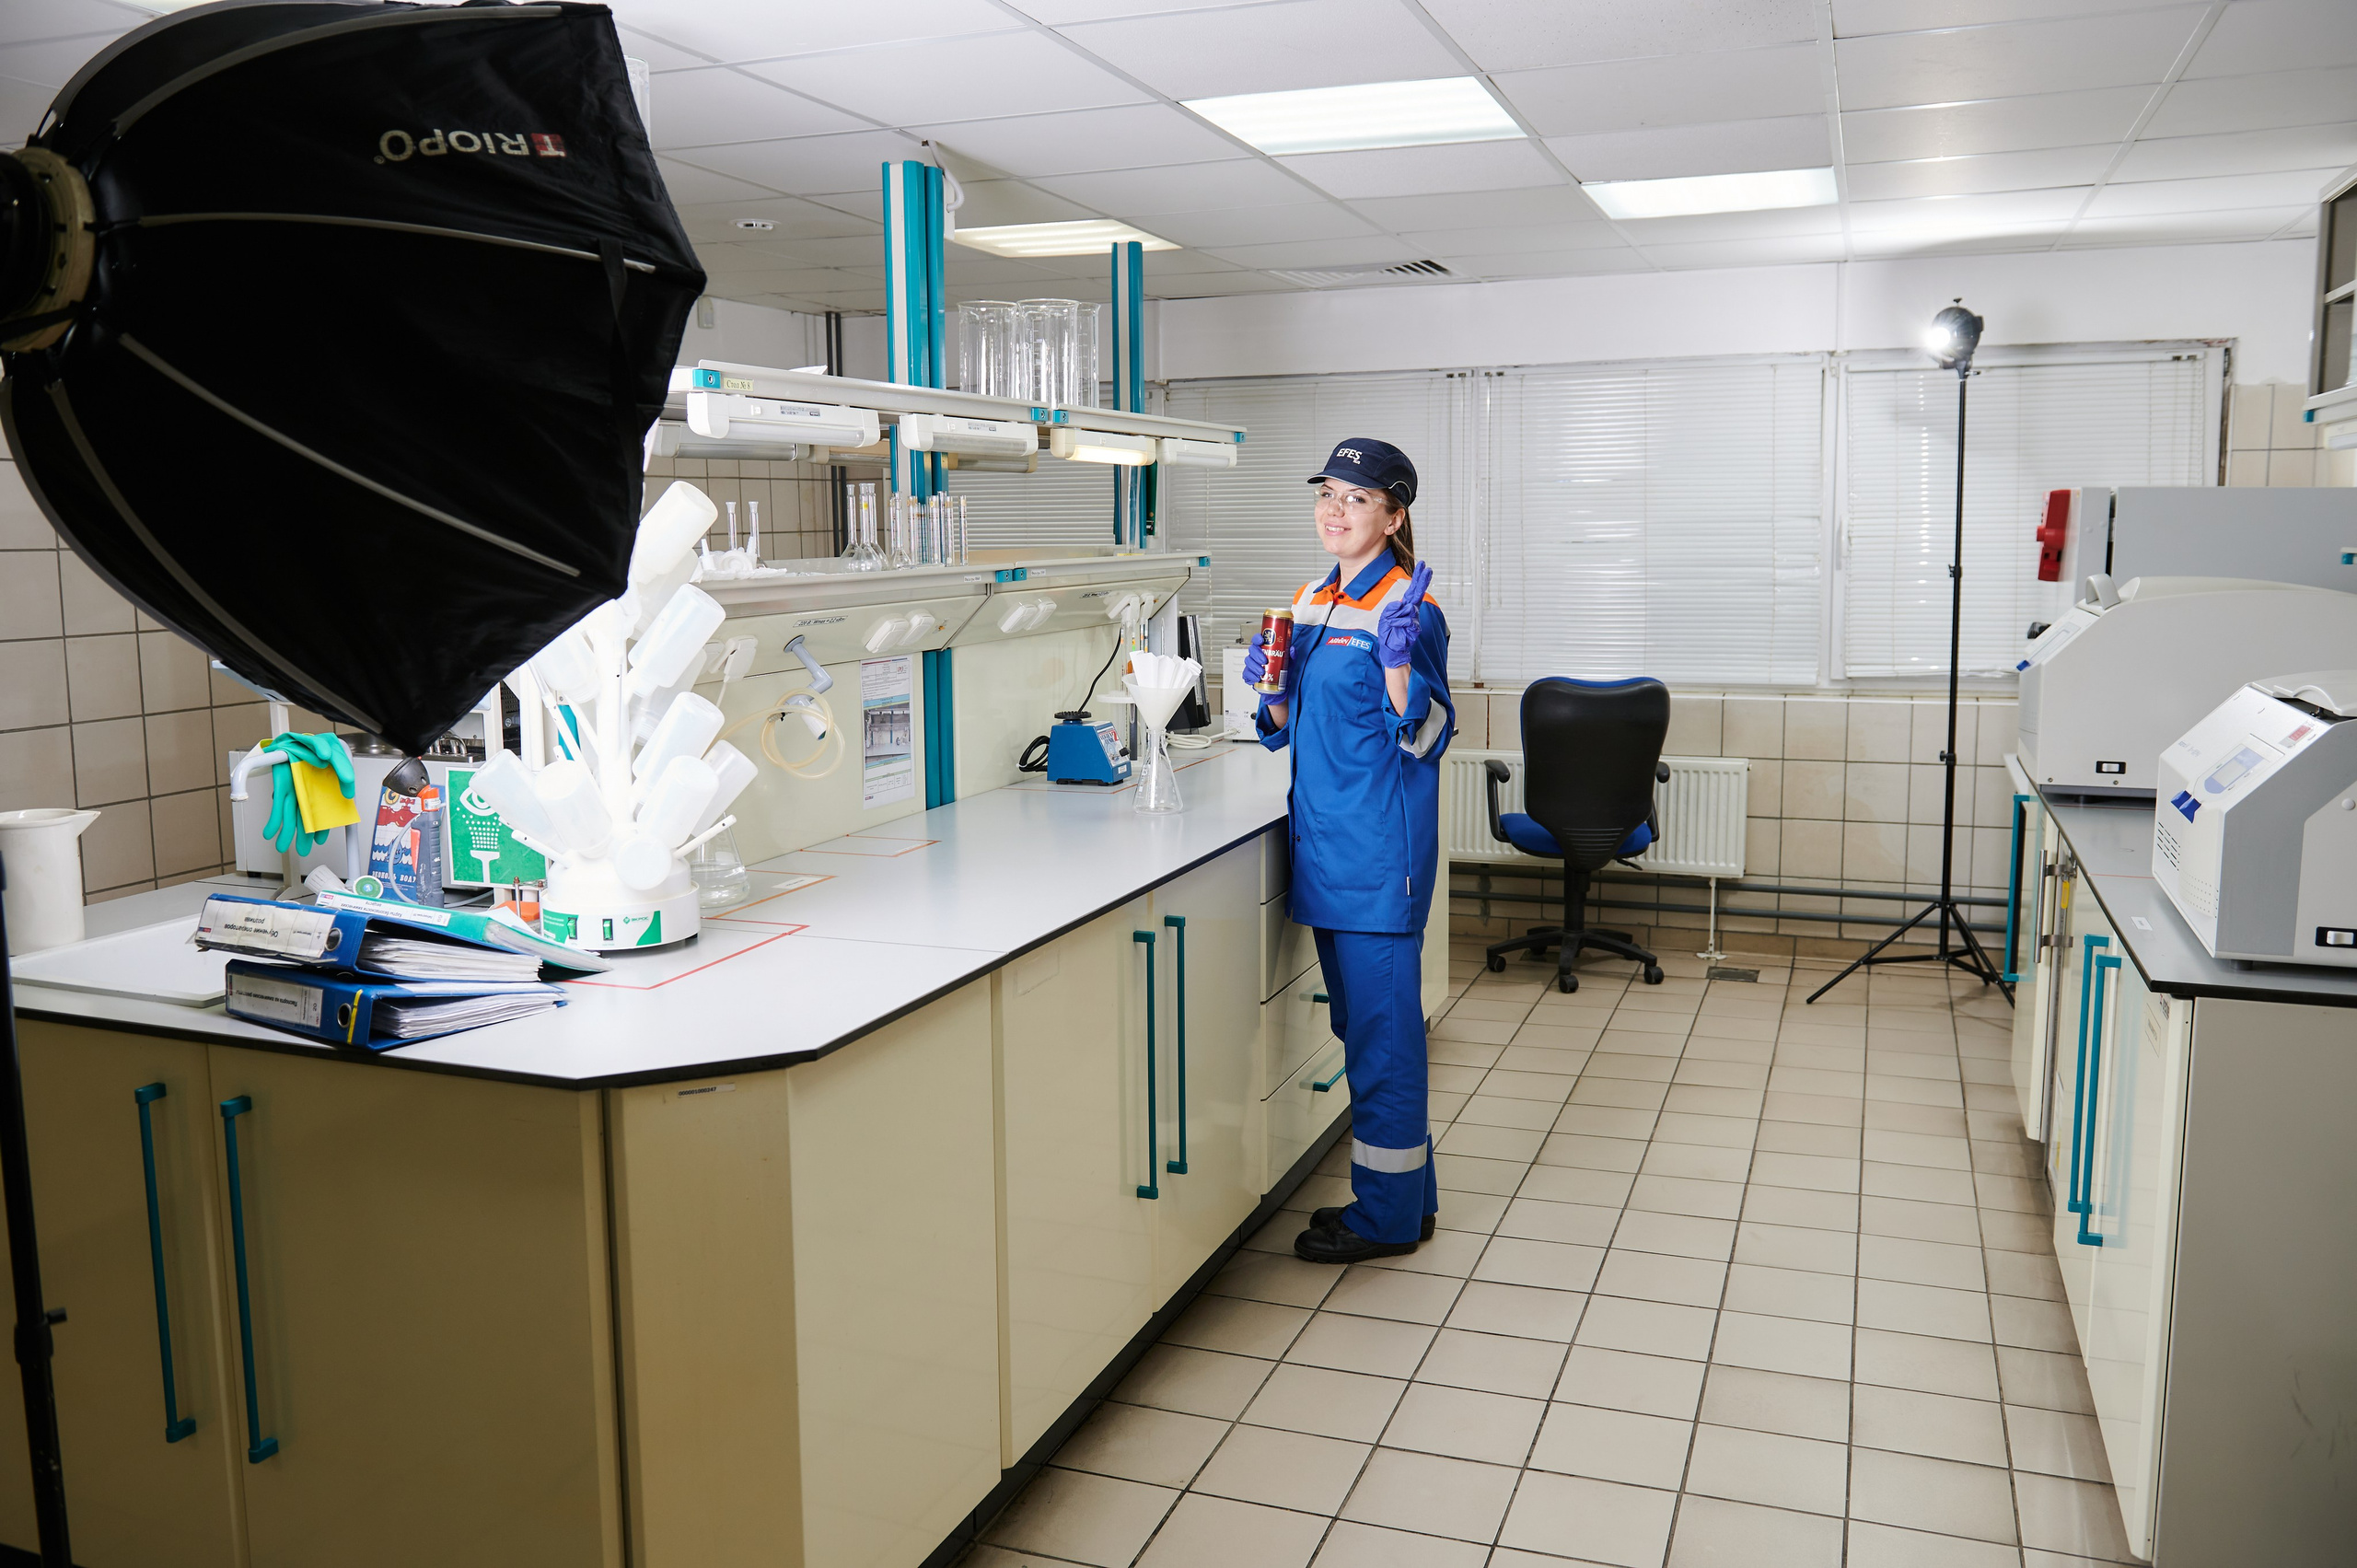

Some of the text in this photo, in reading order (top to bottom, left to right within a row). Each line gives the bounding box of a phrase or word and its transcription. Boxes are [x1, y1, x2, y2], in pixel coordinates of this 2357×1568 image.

[726, 379, 739, 389] Стол
[1337, 447, 1363, 460] EFES
[1351, 638, 1371, 650] EFES
[372, 870, 397, 882] ЭКОНОЬ
[224, 923, 278, 937] Обучение операторов
[280, 998, 298, 1007] Паспорта
